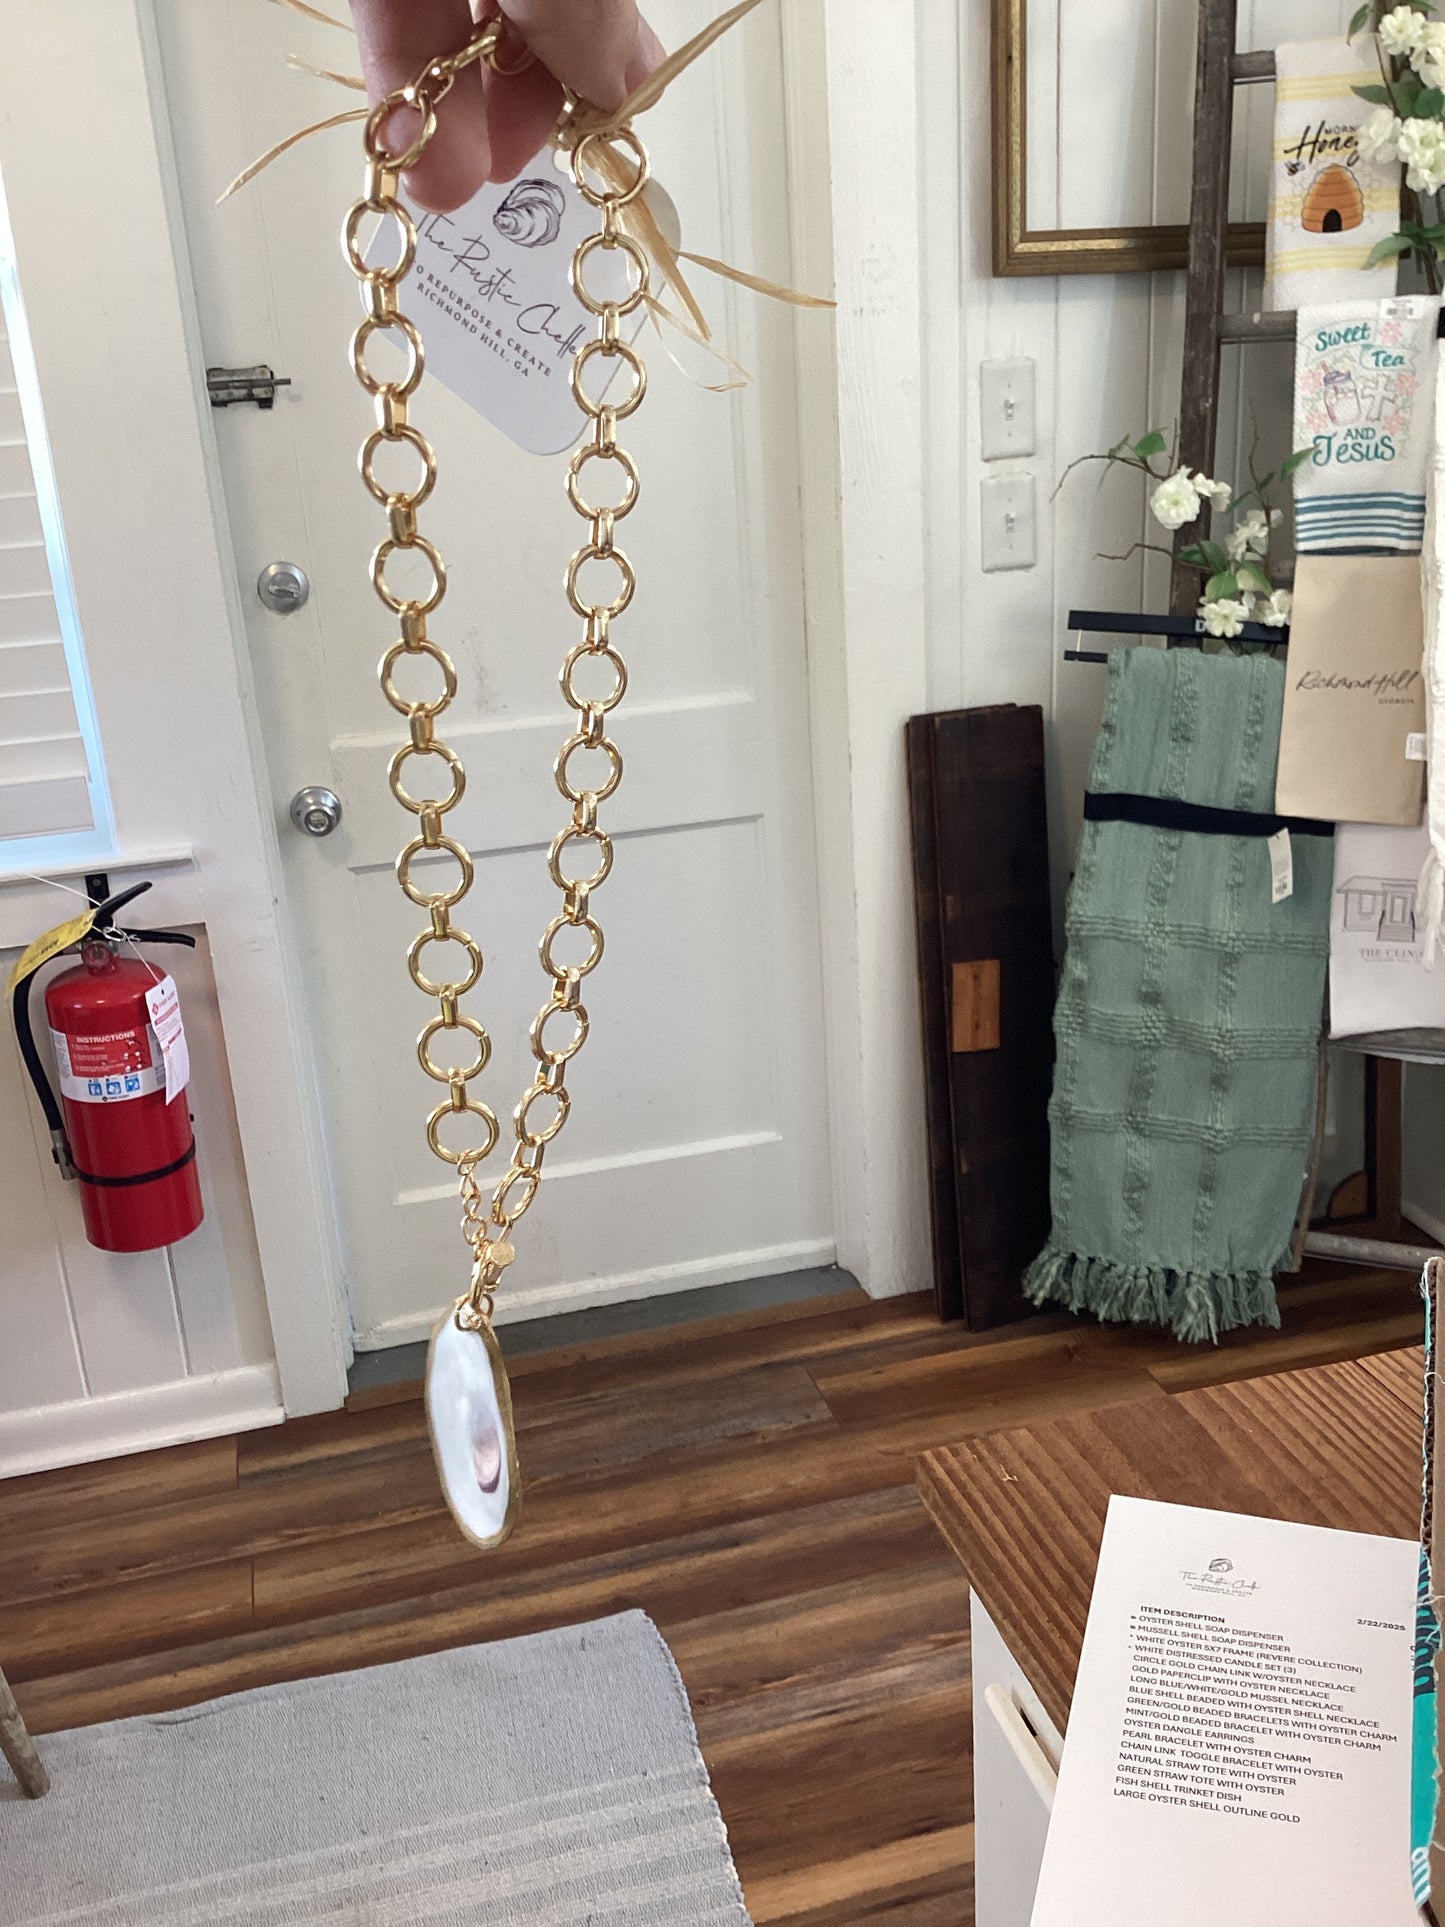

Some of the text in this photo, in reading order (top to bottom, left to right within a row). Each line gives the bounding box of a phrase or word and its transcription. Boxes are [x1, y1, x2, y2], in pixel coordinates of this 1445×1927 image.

[415, 213, 455, 252] The
[450, 234, 521, 306] Rustic
[417, 283, 477, 334] RICHMOND
[514, 360, 530, 378] GA
[426, 273, 494, 330] REPURPOSE
[495, 328, 503, 339] &
[507, 337, 552, 377] CREATE
[1315, 322, 1371, 352] Sweet
[1371, 350, 1404, 367] Tea
[1344, 427, 1376, 440] AND
[76, 1030, 136, 1044] INSTRUCTIONS
[1139, 1616, 1284, 1641] OYSTER SHELL SOAP DISPENSER
[1141, 1606, 1225, 1623] ITEM DESCRIPTION
[1357, 1619, 1406, 1631] 2/22/2025
[1137, 1635, 1165, 1644] WHITE
[1167, 1640, 1202, 1650] OYSTER
[1223, 1647, 1255, 1658] FRAME
[1257, 1653, 1296, 1664] (REVERE
[1298, 1658, 1362, 1674] COLLECTION)
[1138, 1625, 1290, 1652] MUSSELL SHELL SOAP DISPENSER
[1134, 1655, 1356, 1692] CIRCLE GOLD CHAIN LINK W/OYSTER NECKLACE
[1135, 1645, 1163, 1655] WHITE
[1166, 1650, 1222, 1663] DISTRESSED
[1225, 1658, 1262, 1669] CANDLE
[1265, 1664, 1282, 1672] SET
[1130, 1675, 1344, 1712] LONG BLUE/WHITE/GOLD MUSSEL NECKLACE
[1132, 1665, 1330, 1699] GOLD PAPERCLIP WITH OYSTER NECKLACE
[1127, 1697, 1397, 1742] GREEN/GOLD BEADED BRACELETS WITH OYSTER CHARM
[1129, 1686, 1380, 1728] BLUE SHELL BEADED WITH OYSTER SHELL NECKLACE
[1124, 1719, 1254, 1744] OYSTER DANGLE EARRINGS
[1126, 1708, 1381, 1751] MINT/GOLD BEADED BRACELET WITH OYSTER CHARM
[1121, 1741, 1343, 1780] CHAIN LINK TOGGLE BRACELET WITH OYSTER
[1123, 1730, 1311, 1764] PEARL BRACELET WITH OYSTER CHARM
[1118, 1764, 1284, 1796] GREEN STRAW TOTE WITH OYSTER
[1119, 1752, 1296, 1785] NATURAL STRAW TOTE WITH OYSTER
[1114, 1789, 1300, 1823] LARGE OYSTER SHELL OUTLINE GOLD
[1116, 1776, 1241, 1802] FISH SHELL TRINKET DISH
